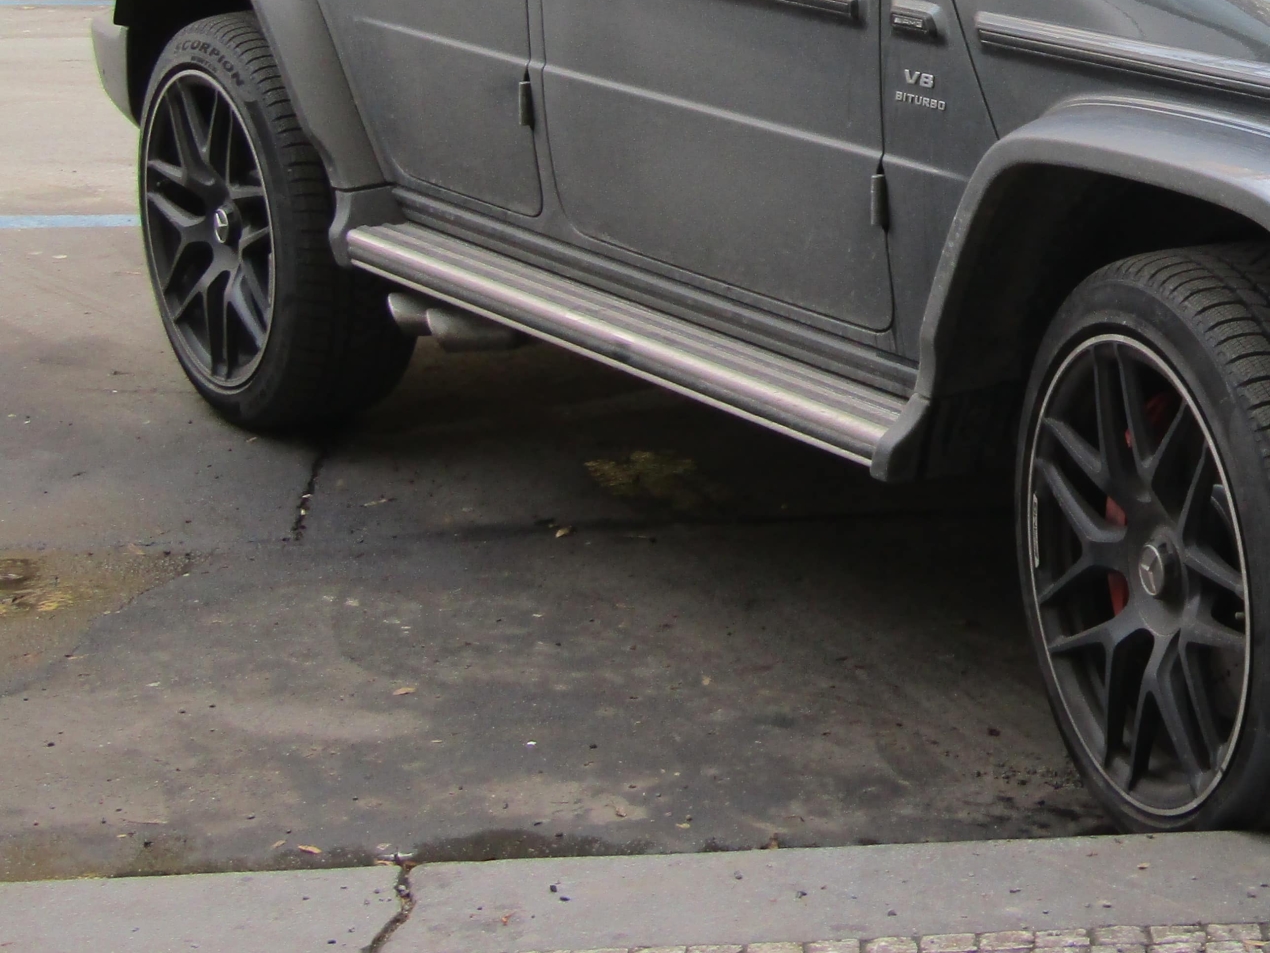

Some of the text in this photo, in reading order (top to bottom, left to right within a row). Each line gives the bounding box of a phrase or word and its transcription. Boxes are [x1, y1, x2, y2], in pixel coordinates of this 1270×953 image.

[173, 39, 245, 87] SCORPION
[904, 68, 935, 89] V8
[895, 90, 946, 110] BITURBO
